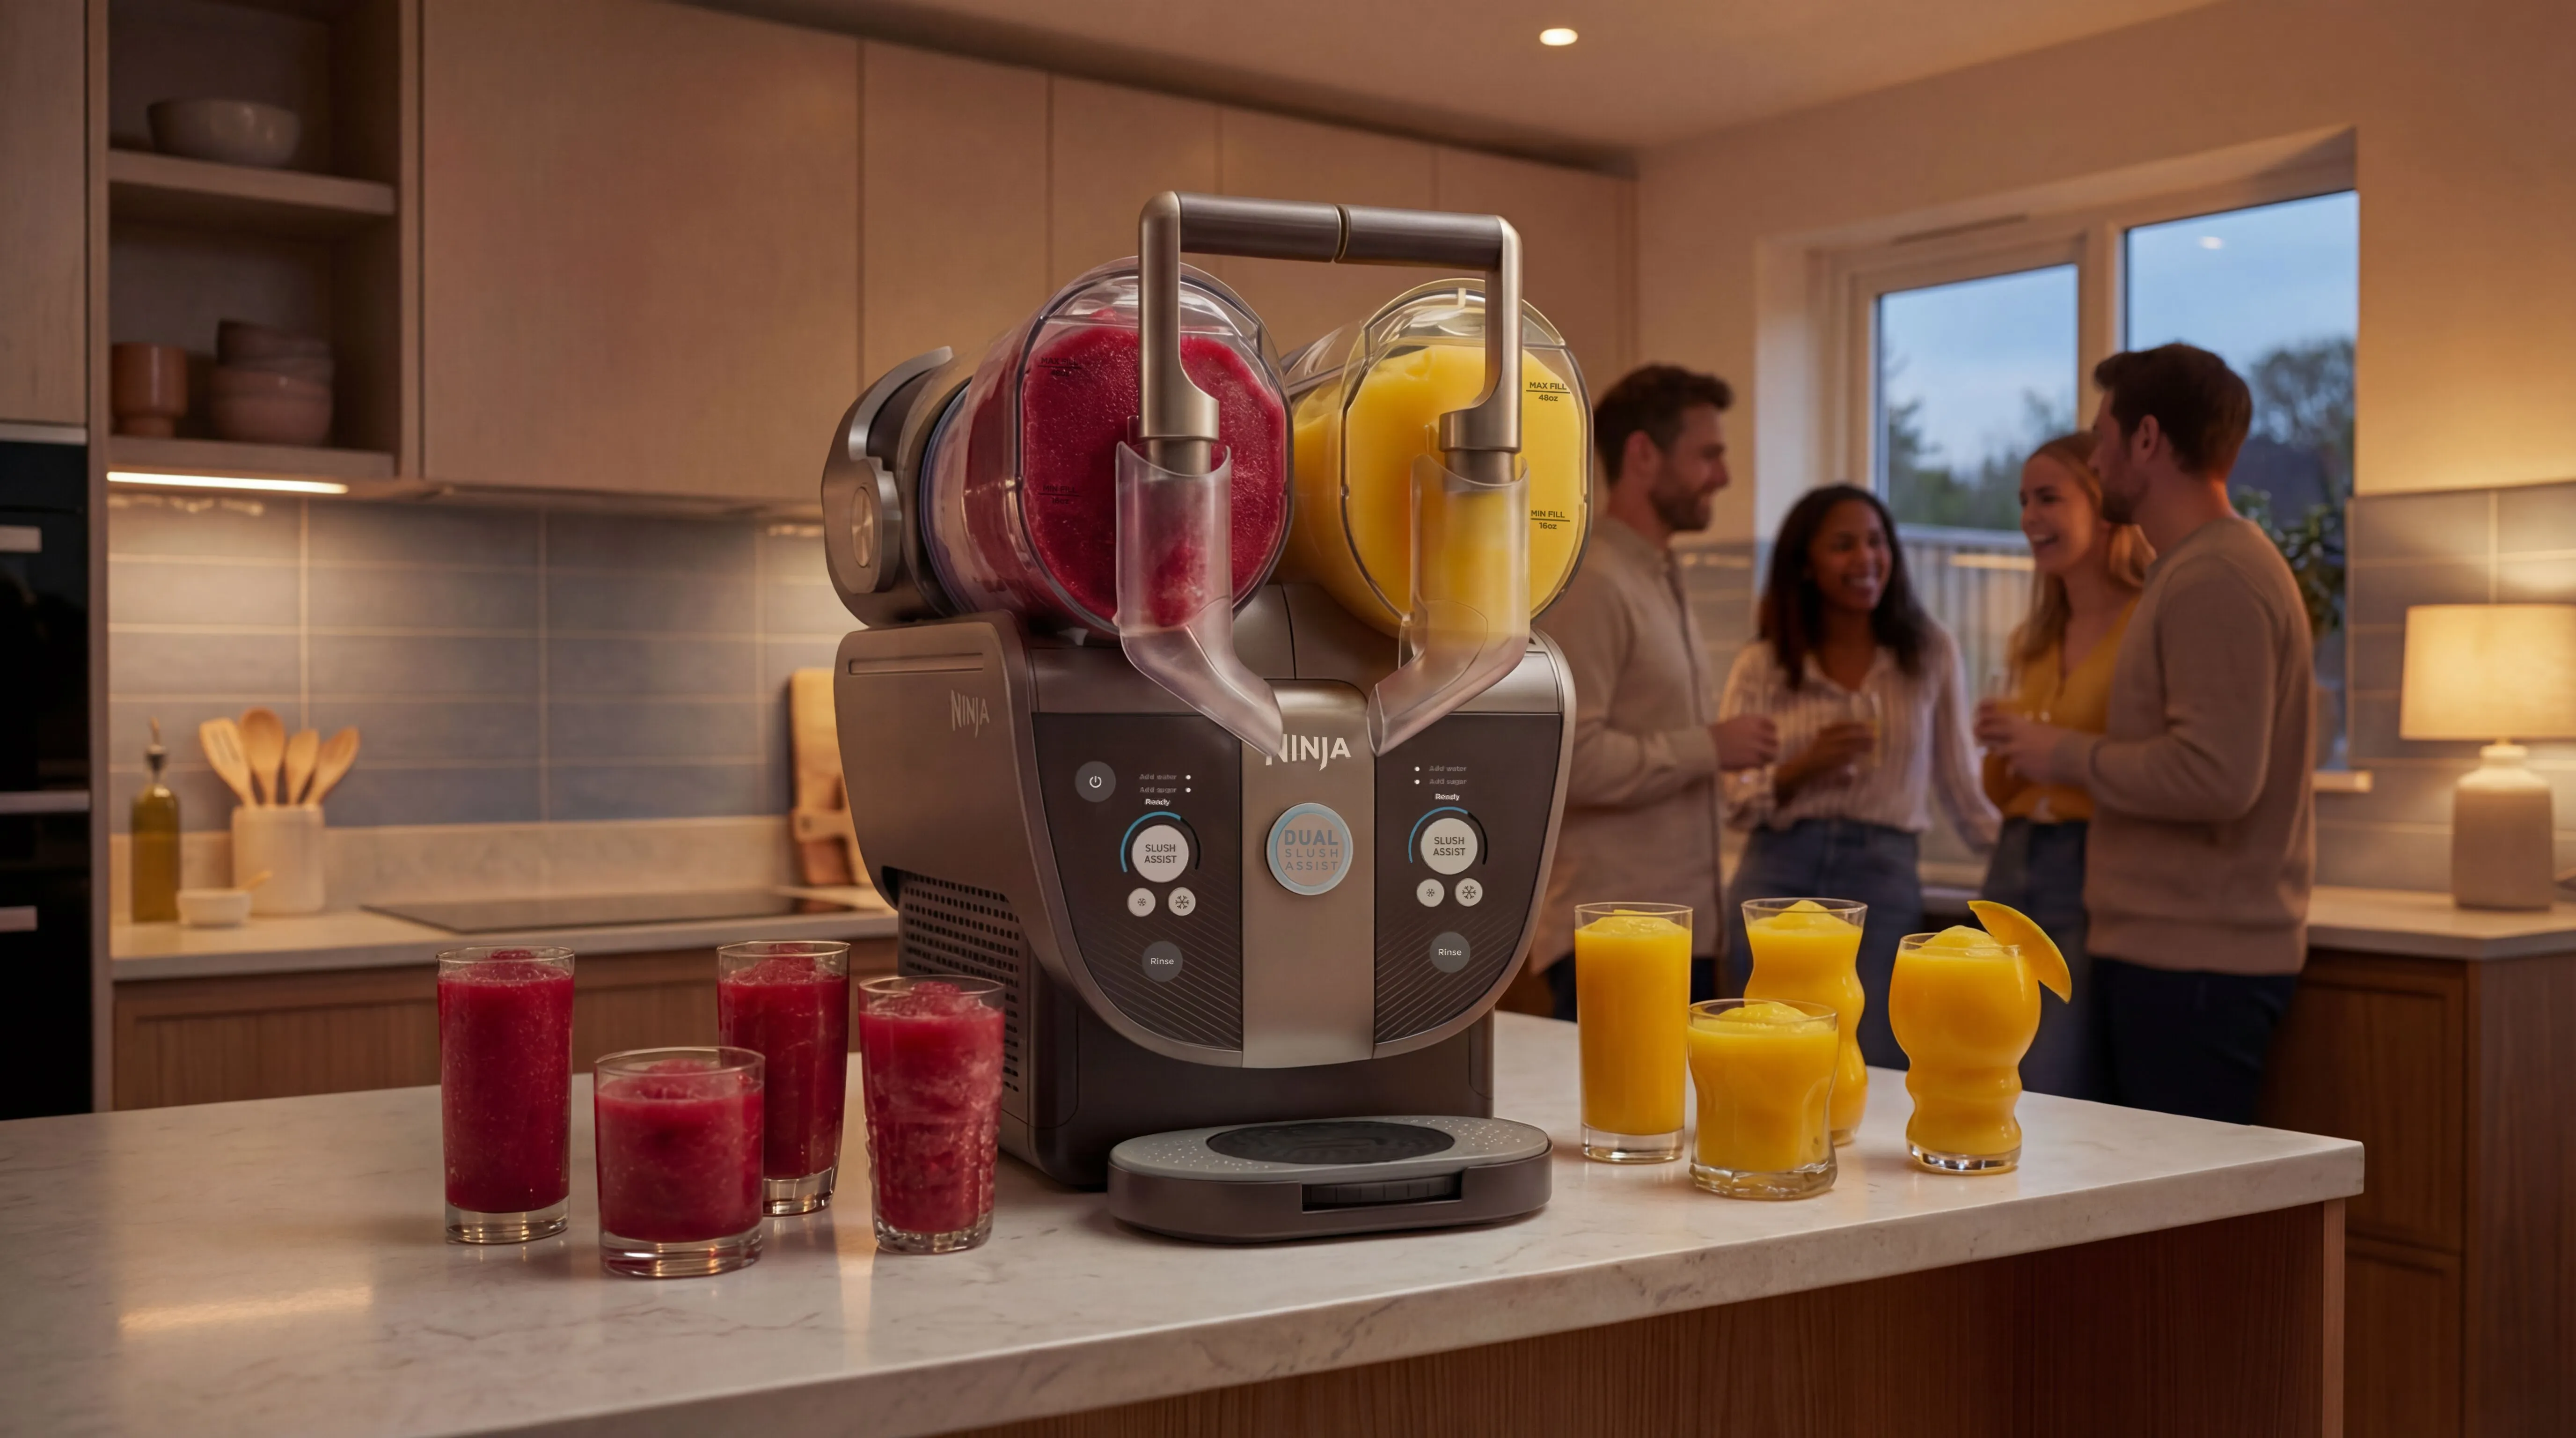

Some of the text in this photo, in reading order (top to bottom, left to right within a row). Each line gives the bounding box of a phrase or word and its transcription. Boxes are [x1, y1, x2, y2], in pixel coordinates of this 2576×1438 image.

[951, 689, 990, 738] NINJA
[1284, 829, 1339, 845] DUAL
[1285, 848, 1338, 858] SLUSH
[1285, 861, 1338, 870] ASSIST
